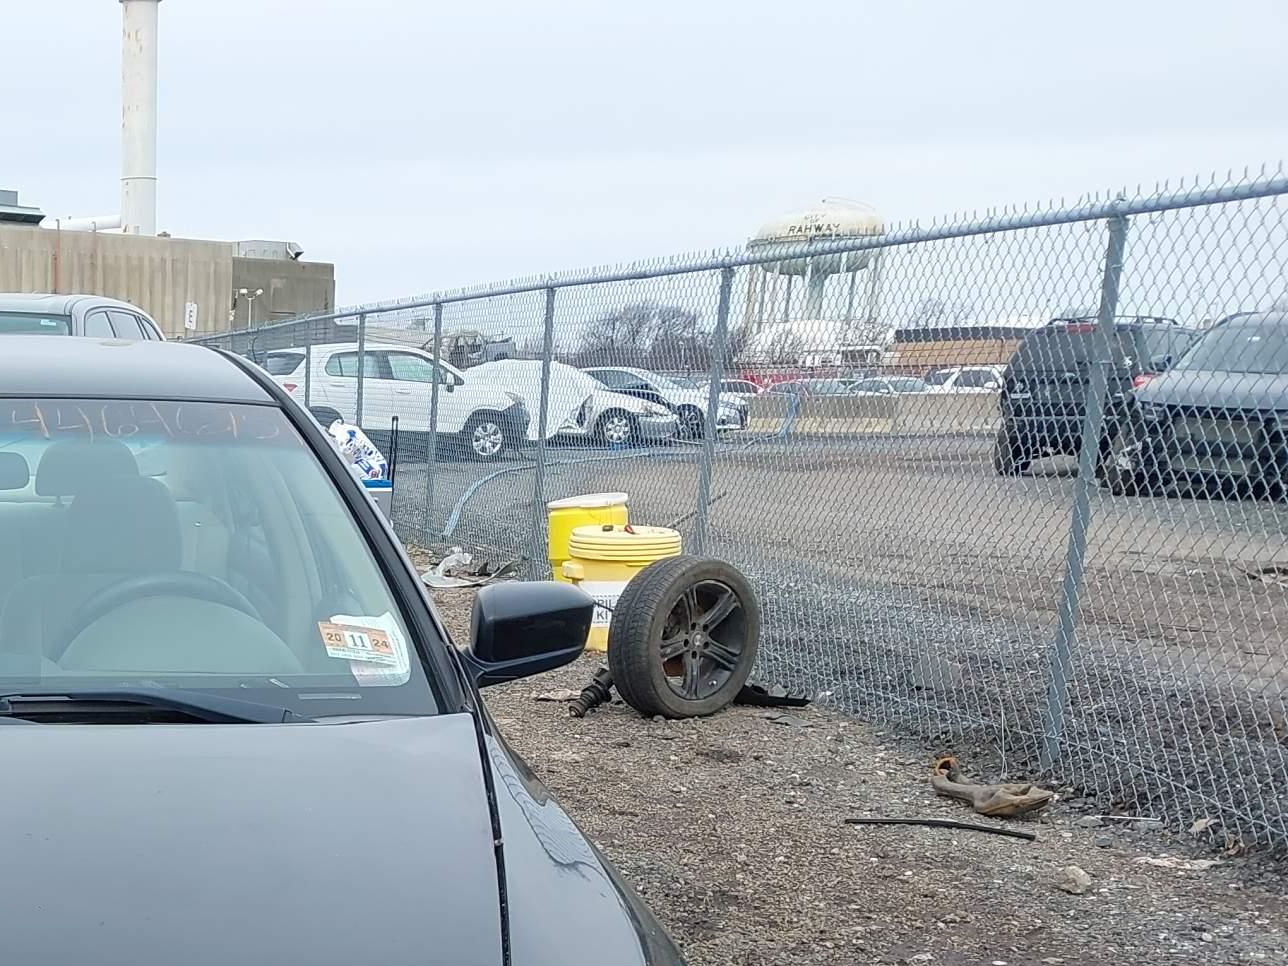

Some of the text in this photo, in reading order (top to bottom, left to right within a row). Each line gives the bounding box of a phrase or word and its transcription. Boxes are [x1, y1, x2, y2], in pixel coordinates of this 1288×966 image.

[788, 223, 840, 234] RAHWAY
[596, 611, 608, 620] KI
[326, 632, 389, 648] 20 11 24
